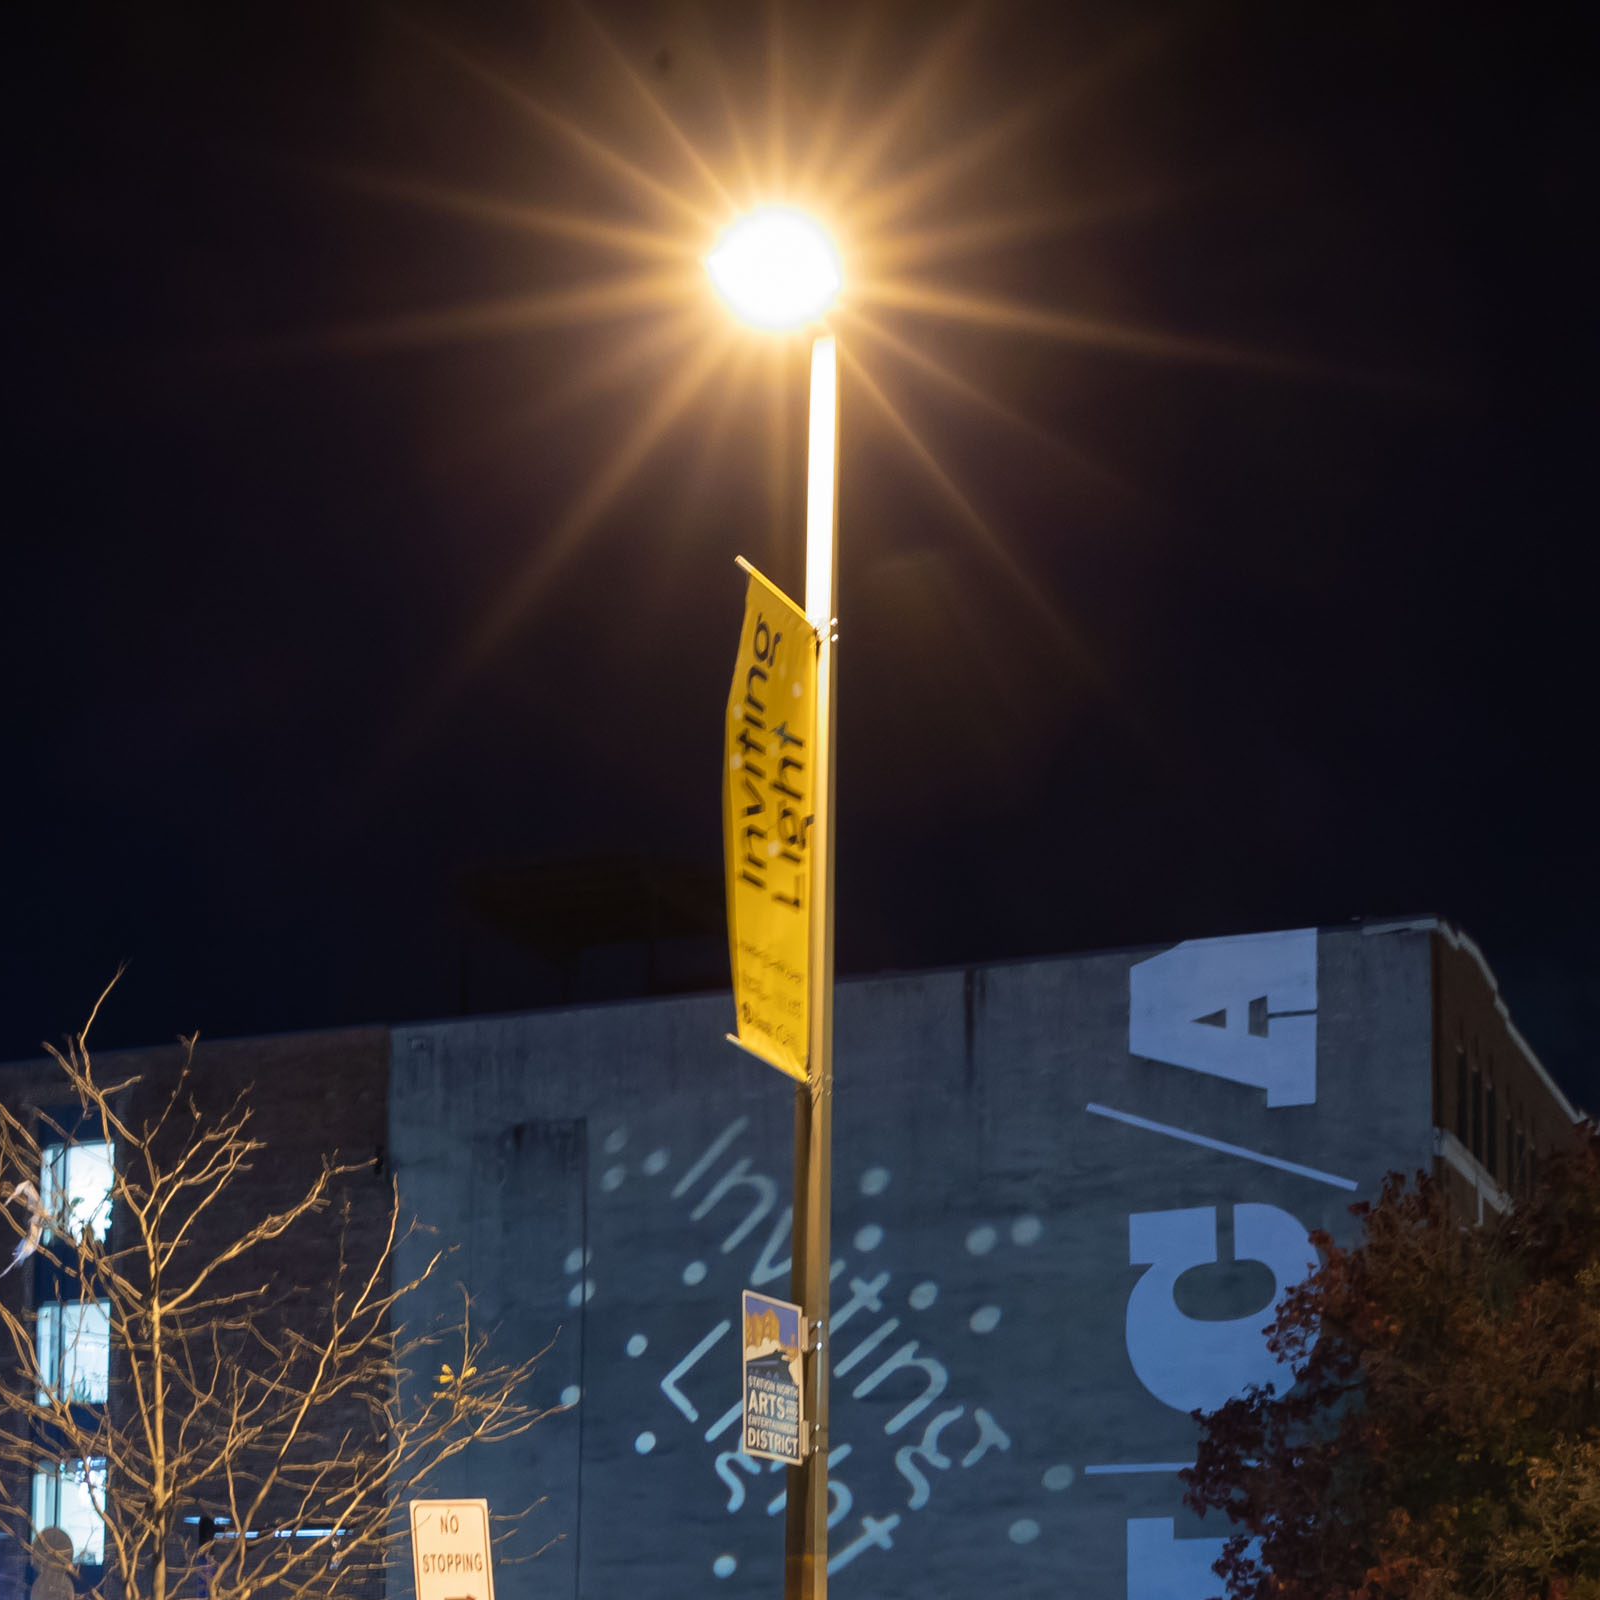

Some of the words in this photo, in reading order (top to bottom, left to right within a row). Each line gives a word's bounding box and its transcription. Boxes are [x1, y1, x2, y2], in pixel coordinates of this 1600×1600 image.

[736, 612, 782, 889] Inviting
[770, 721, 815, 911] Light
[748, 1375, 775, 1393] STATION
[776, 1383, 798, 1399] NORTH
[748, 1389, 785, 1420] ARTS
[748, 1414, 798, 1436] ENTERTAINMENT
[748, 1427, 798, 1456] DISTRICT
[440, 1514, 459, 1535] NO
[422, 1553, 483, 1574] STOPPING
